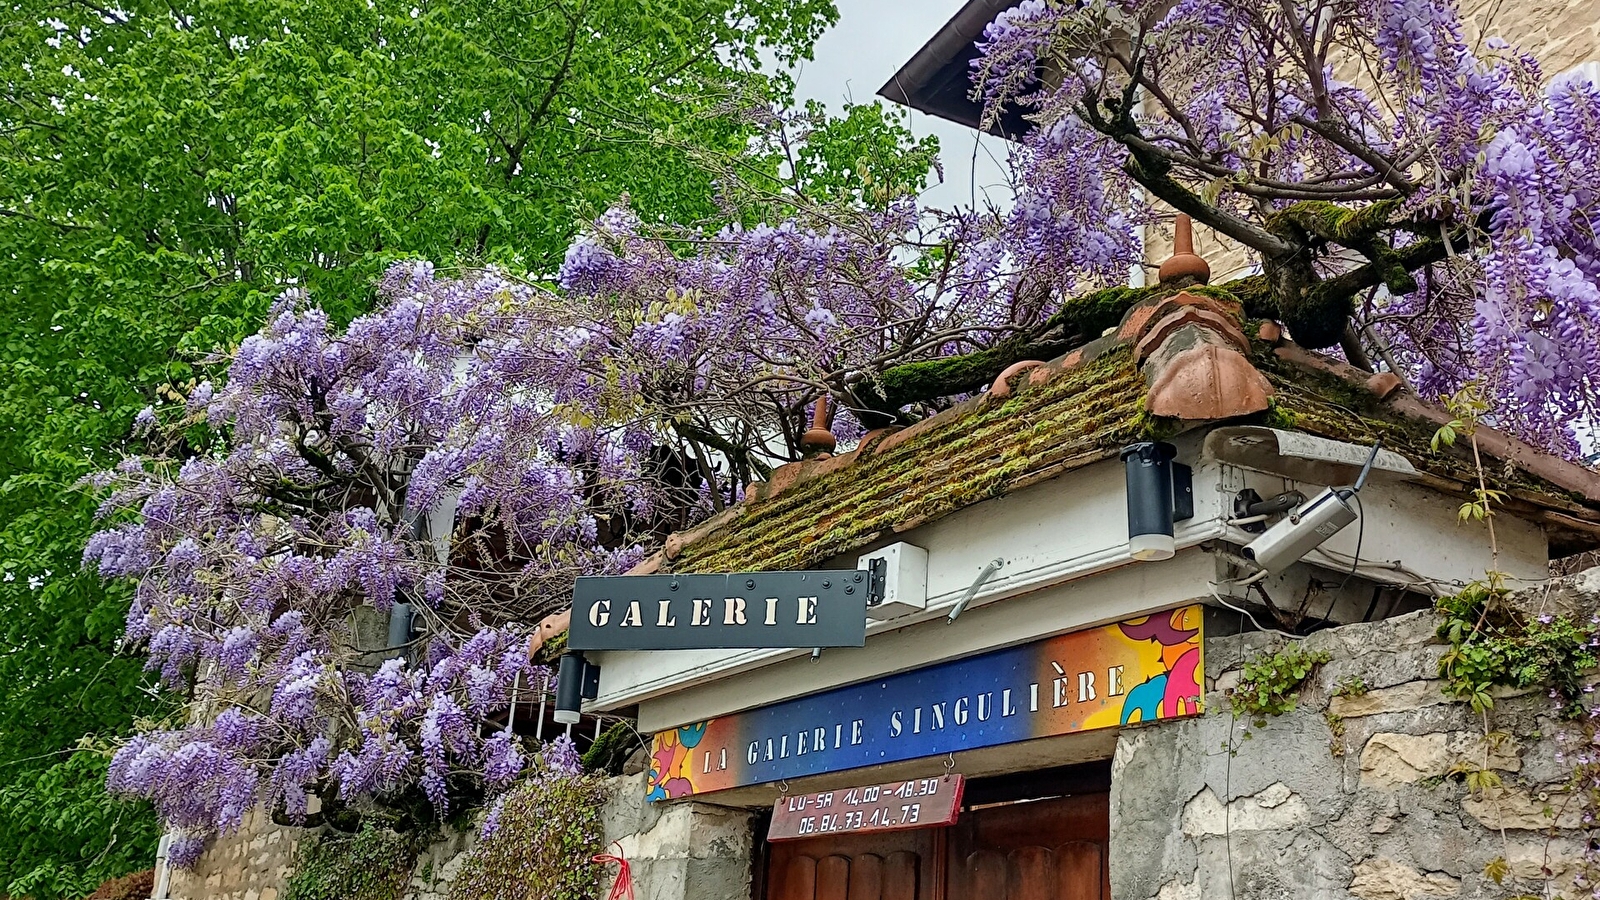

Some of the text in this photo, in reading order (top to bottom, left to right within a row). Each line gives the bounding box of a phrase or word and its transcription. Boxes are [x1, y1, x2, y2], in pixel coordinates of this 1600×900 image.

[588, 596, 818, 627] GALERIE
[702, 661, 1125, 774] LA GALERIE SINGULIÈRE
[788, 792, 834, 812] LU-SA
